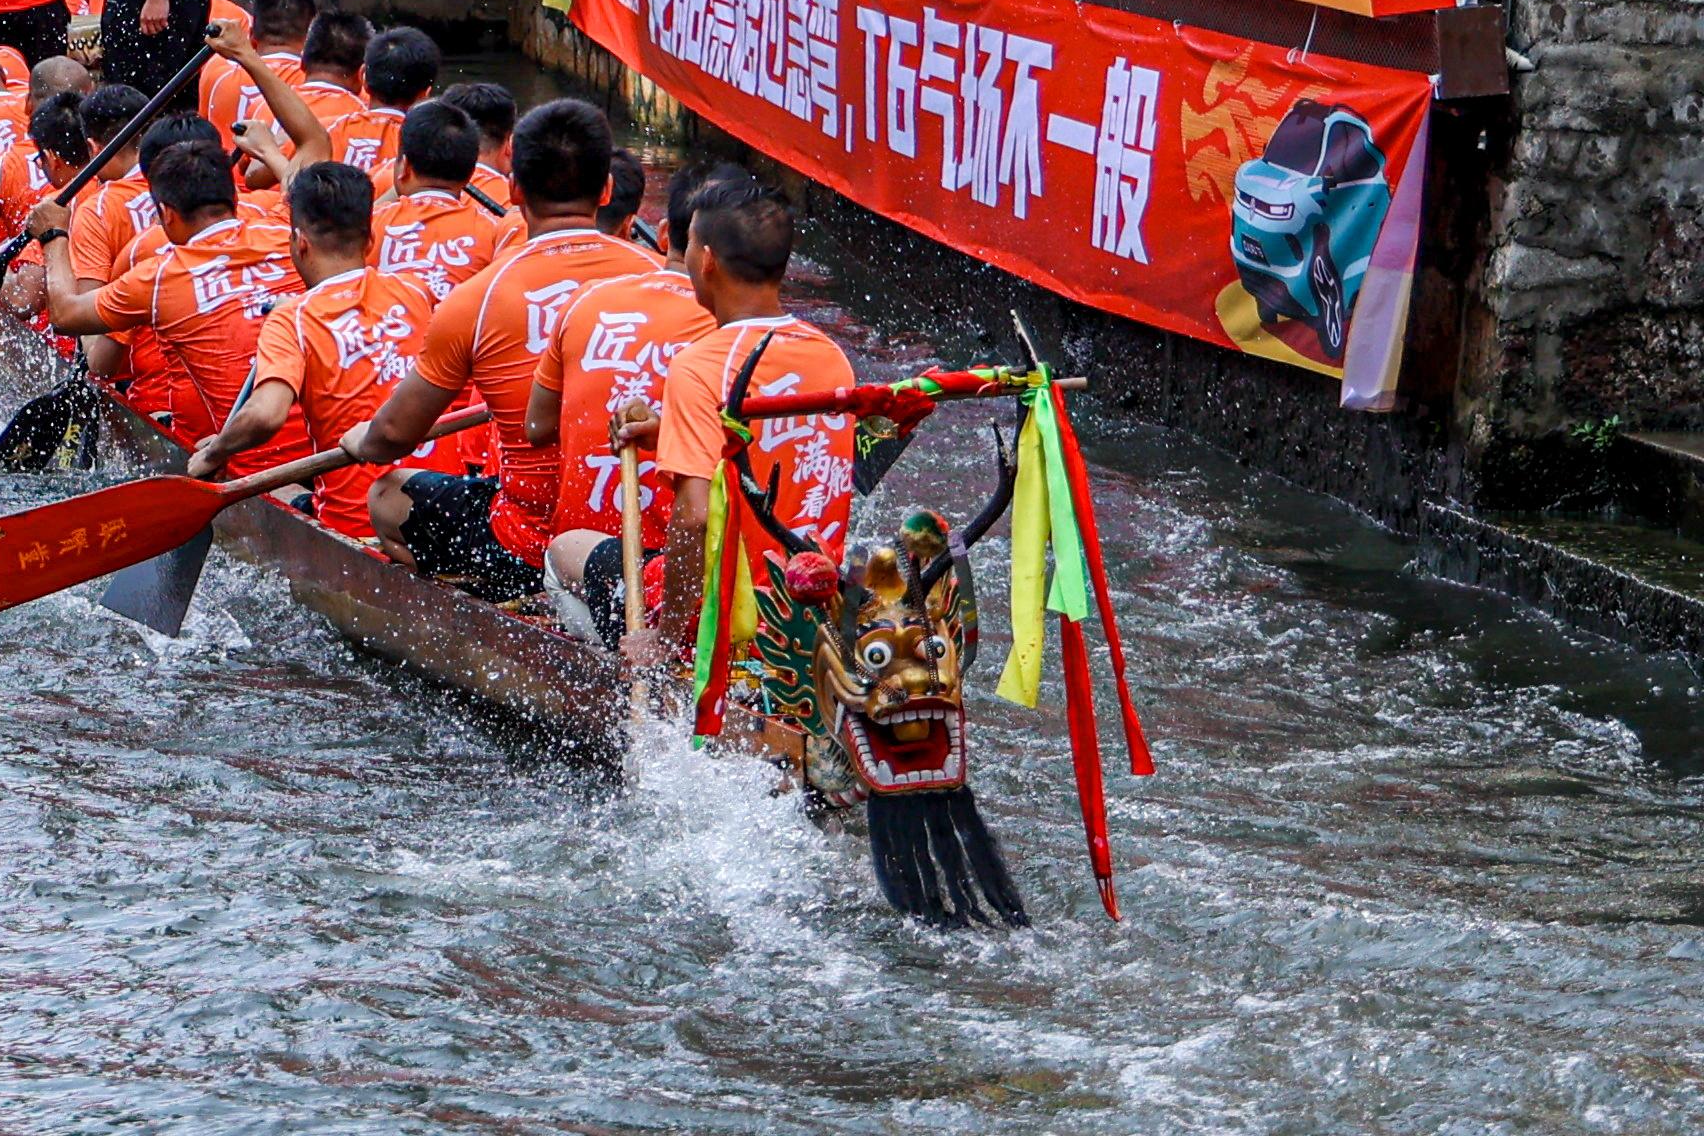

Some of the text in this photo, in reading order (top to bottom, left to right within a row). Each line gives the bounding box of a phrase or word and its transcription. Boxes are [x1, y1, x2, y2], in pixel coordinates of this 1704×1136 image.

[377, 221, 476, 274] 匠心
[189, 253, 286, 314] 匠心
[326, 304, 413, 369] 匠心
[580, 311, 692, 377] 匠心
[792, 431, 853, 501] 满舵
[797, 484, 828, 522] 看
